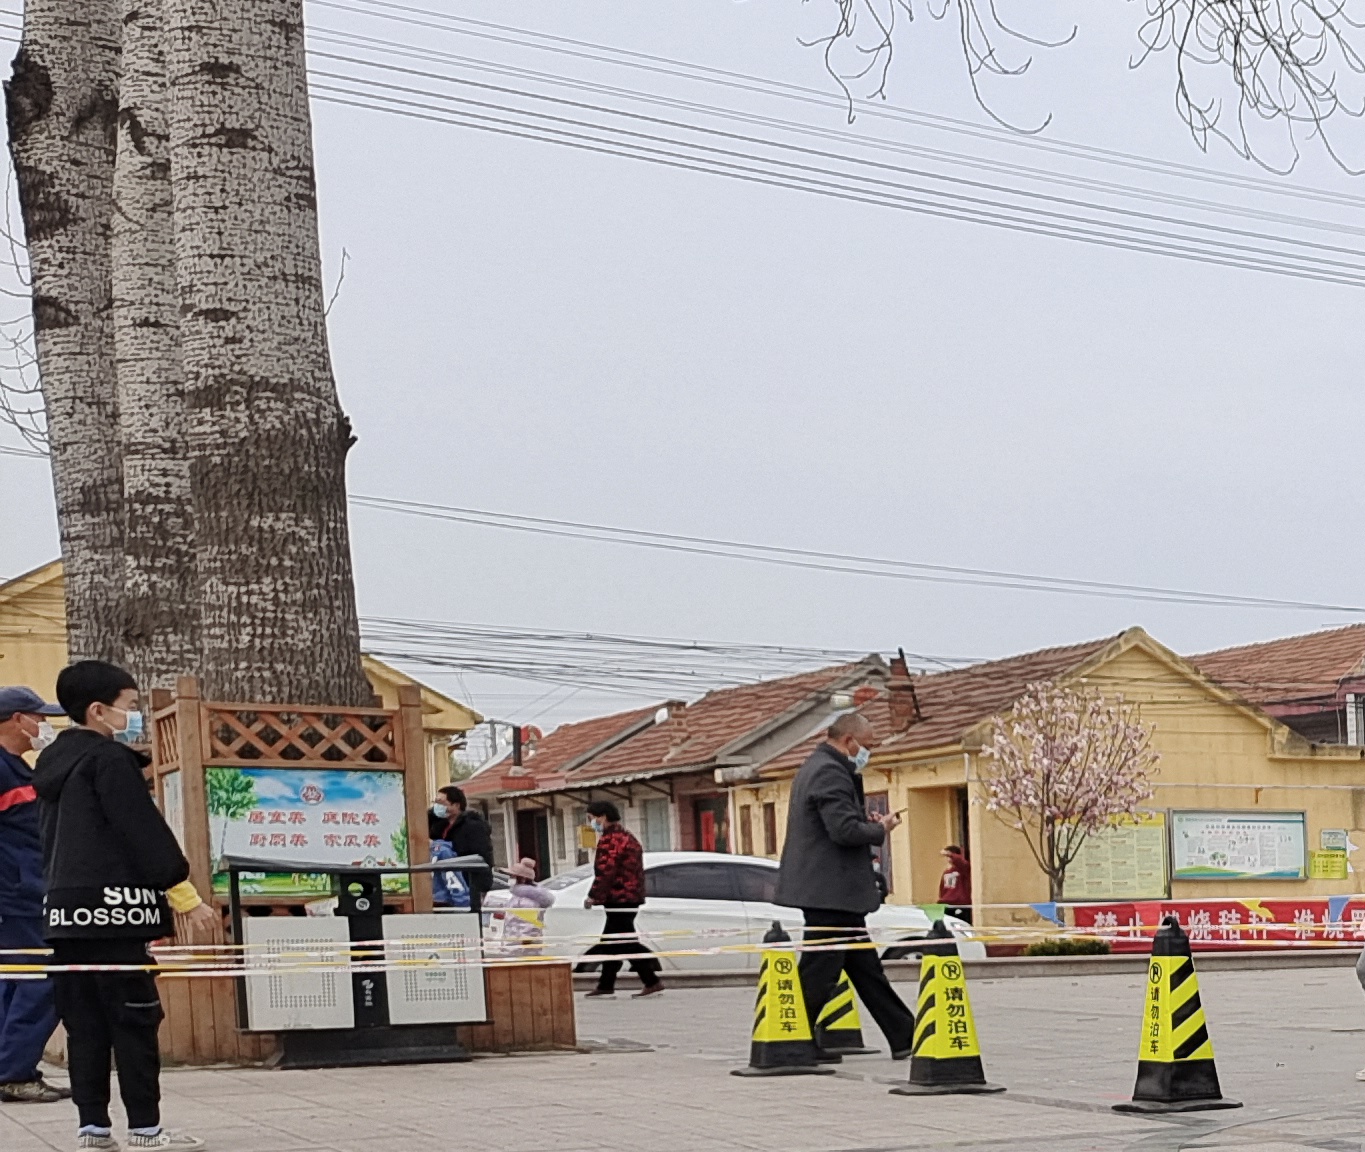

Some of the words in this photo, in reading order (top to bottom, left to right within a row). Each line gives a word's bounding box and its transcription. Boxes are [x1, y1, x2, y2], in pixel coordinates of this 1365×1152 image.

[49, 907, 161, 927] BLOSSOM
[776, 979, 797, 1033] 请勿泊车
[944, 987, 970, 1051] 请勿泊车
[1150, 987, 1160, 1054] 请勿泊车
